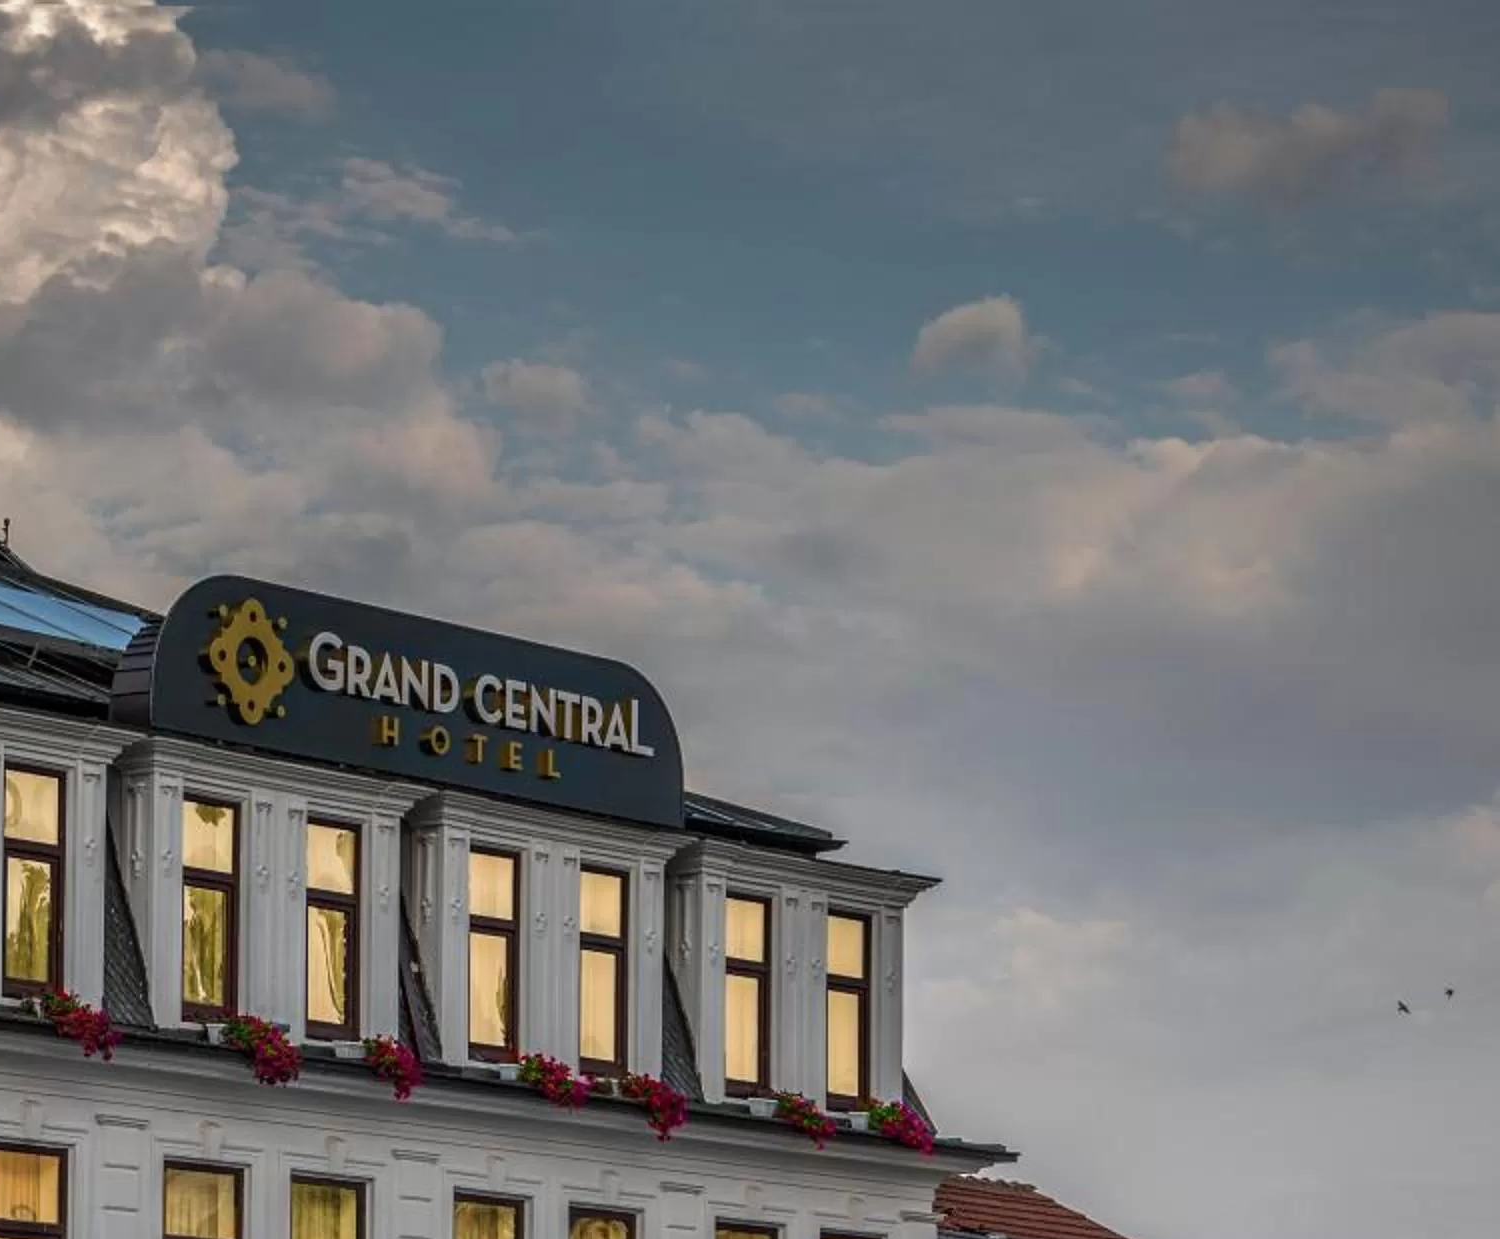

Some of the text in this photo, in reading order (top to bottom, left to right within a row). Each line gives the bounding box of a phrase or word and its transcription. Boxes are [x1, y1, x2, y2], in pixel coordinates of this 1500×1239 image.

[308, 632, 654, 757] GRAND CENTRAL
[374, 716, 561, 779] HOTEL
